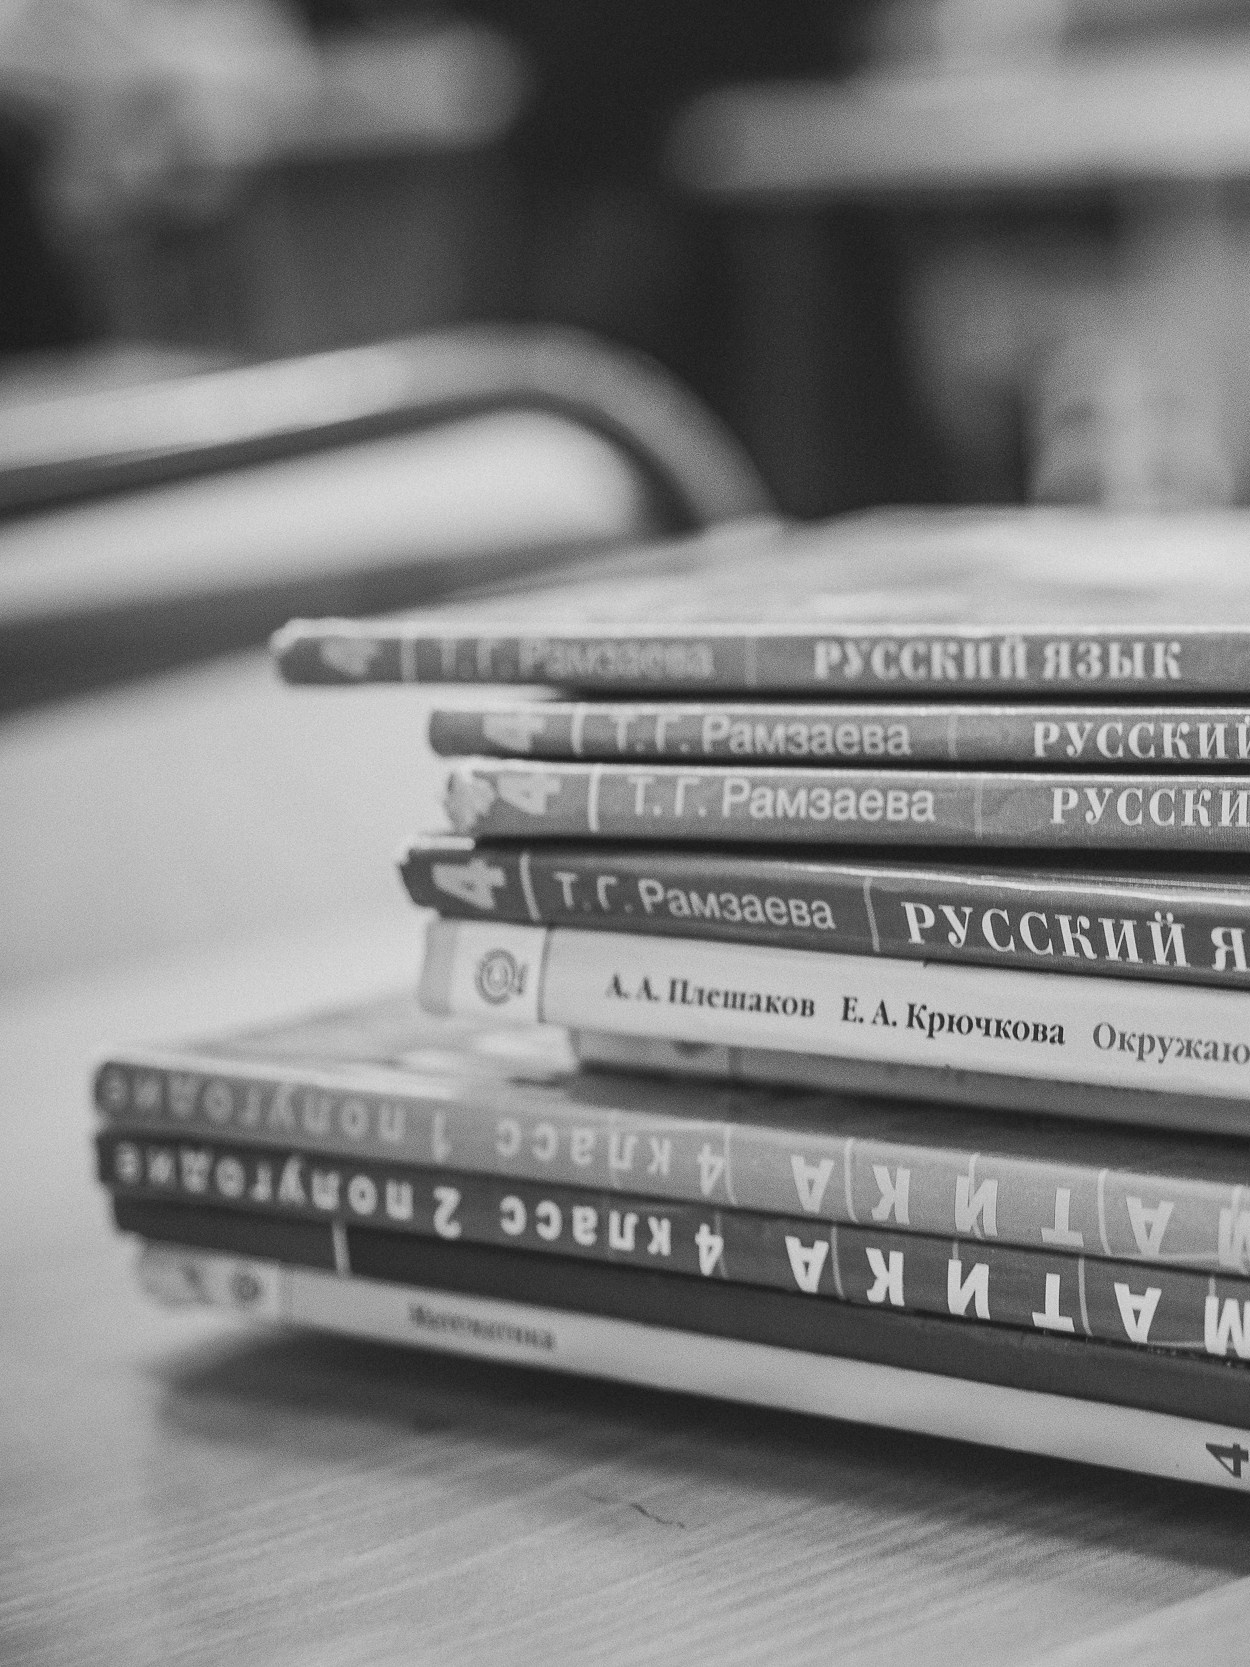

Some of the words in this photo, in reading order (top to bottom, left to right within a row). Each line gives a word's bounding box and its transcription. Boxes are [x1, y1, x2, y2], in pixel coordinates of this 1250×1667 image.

[812, 632, 1027, 681] РУССКИЙ
[1042, 639, 1183, 681] ЯЗЫК
[701, 714, 913, 758] Рамзаева
[720, 776, 936, 823] Рамзаева
[637, 877, 837, 931] Рамзаева
[901, 900, 1192, 969] РУССКИЙ
[668, 977, 817, 1019] Плешаков
[905, 1001, 1067, 1047] Крючкова
[103, 1072, 407, 1142] полугодие
[497, 1117, 672, 1177] класс
[696, 1143, 726, 1197] 4
[115, 1140, 414, 1222] полугодие
[432, 1185, 463, 1239] 2
[499, 1195, 672, 1257] класс
[695, 1223, 725, 1277] 4
[1205, 1441, 1250, 1479] 4
